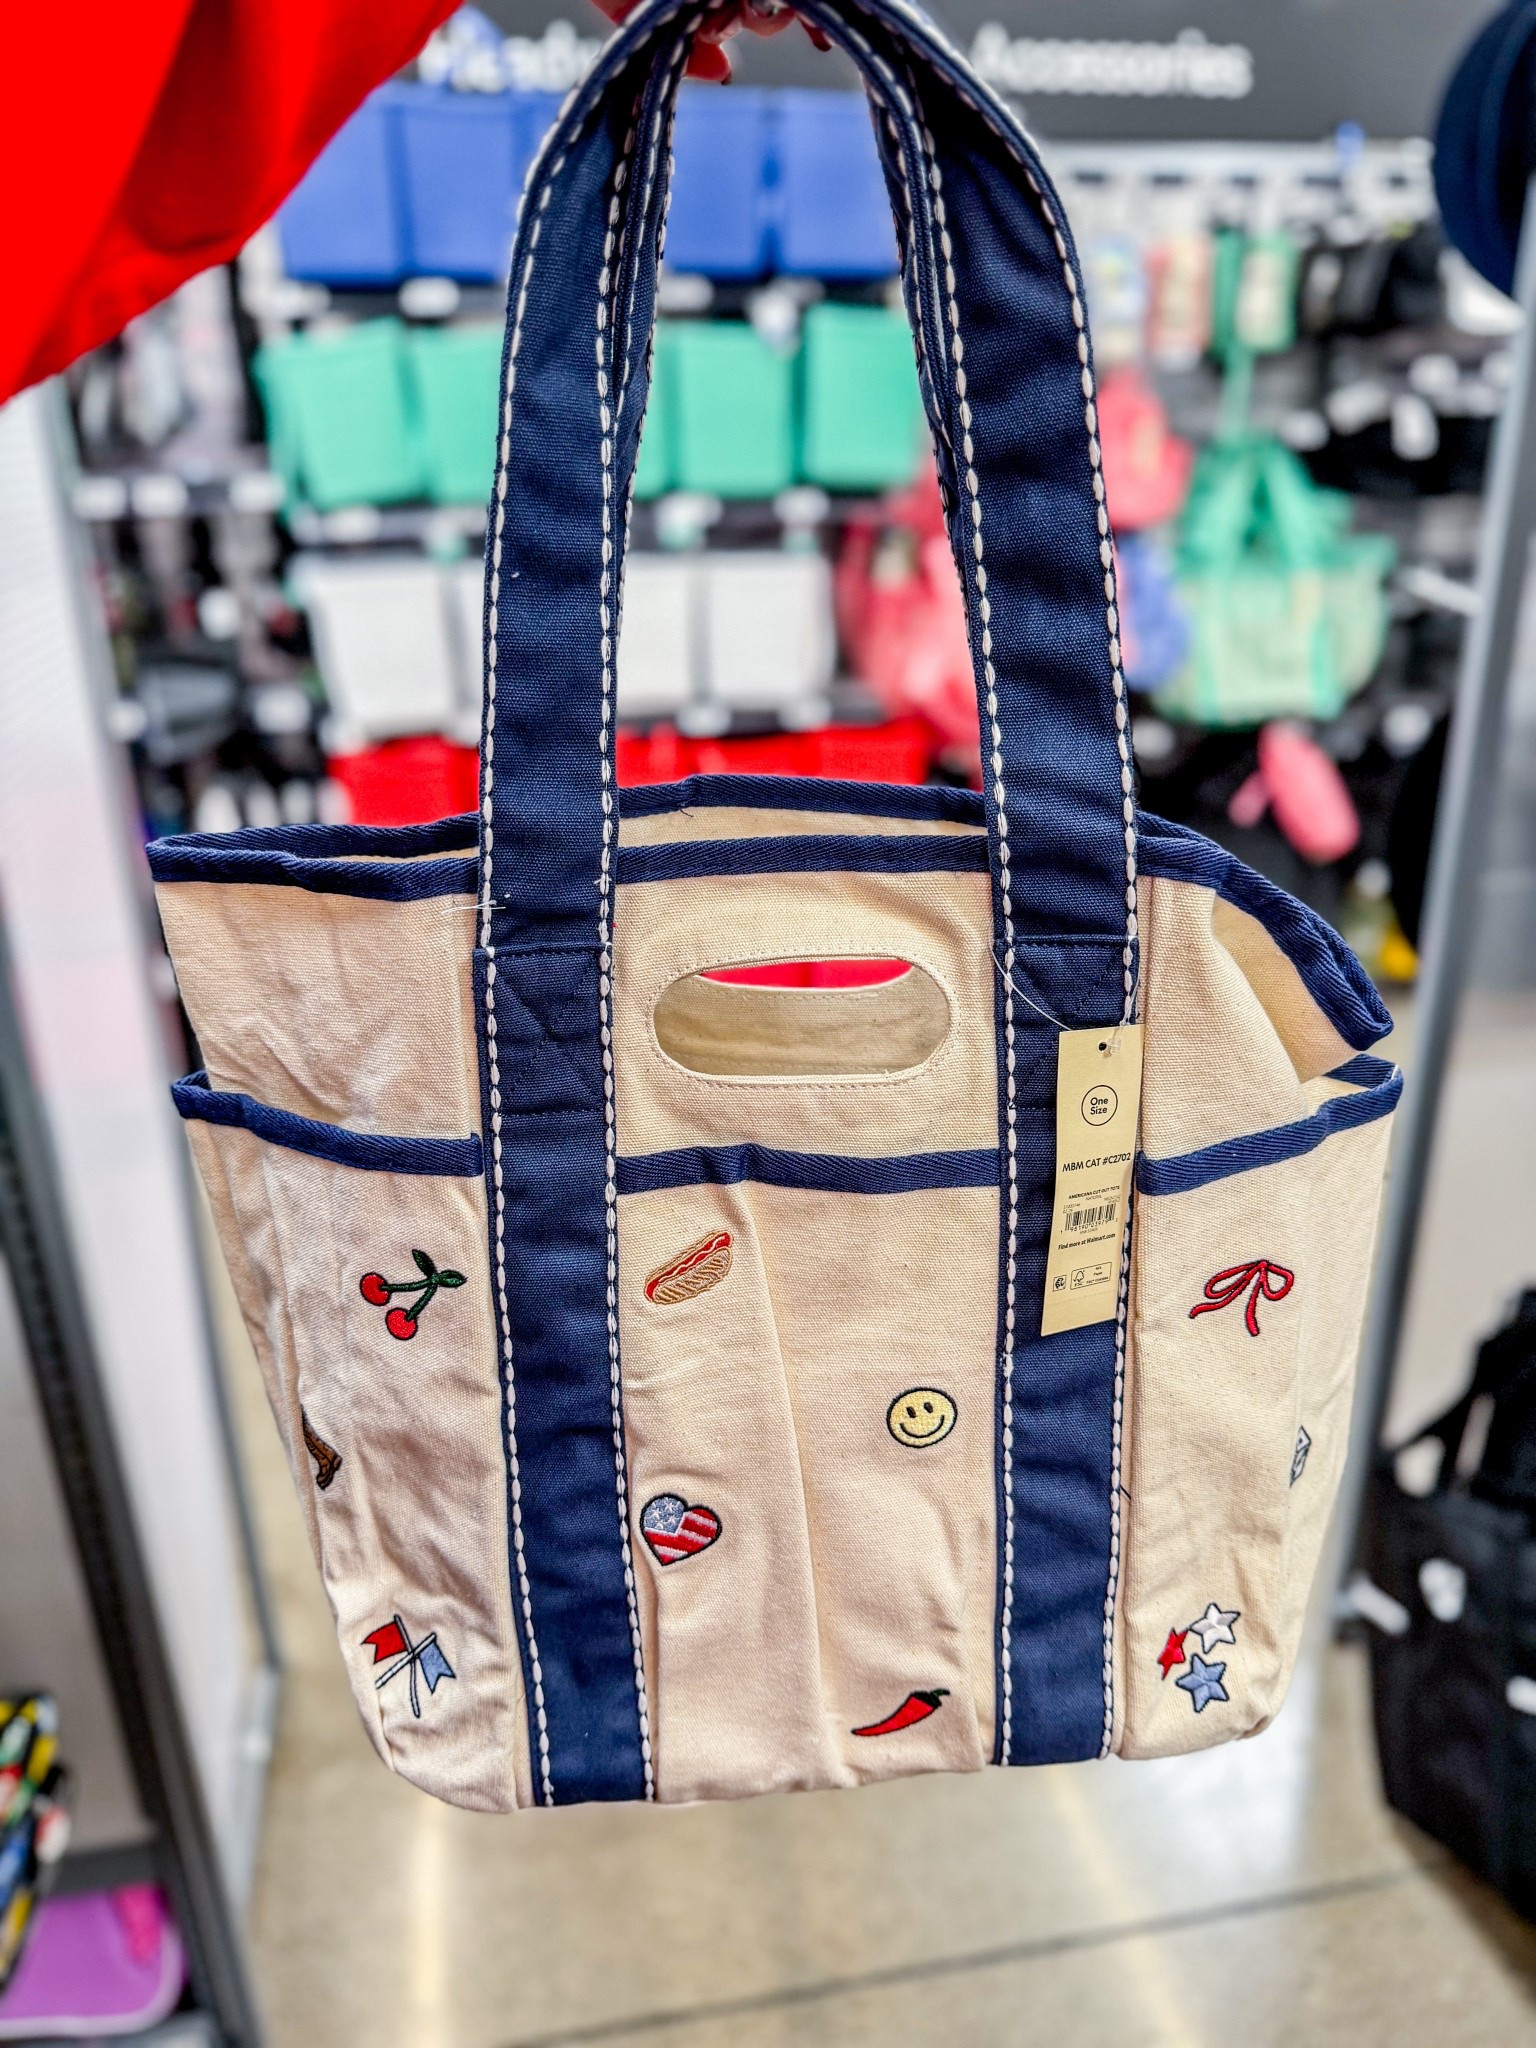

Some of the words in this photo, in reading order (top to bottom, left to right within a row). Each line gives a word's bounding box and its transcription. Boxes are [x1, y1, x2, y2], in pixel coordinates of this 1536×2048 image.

[970, 22, 1253, 99] Accessories
[1090, 1097, 1108, 1106] One
[1090, 1106, 1108, 1115] Size
[1062, 1161, 1084, 1172] MBM
[1085, 1157, 1102, 1168] CAT
[1102, 1152, 1131, 1165] #C2702
[1058, 1242, 1069, 1250] Find
[1068, 1240, 1081, 1248] more
[1086, 1233, 1116, 1244] Walmart.com
